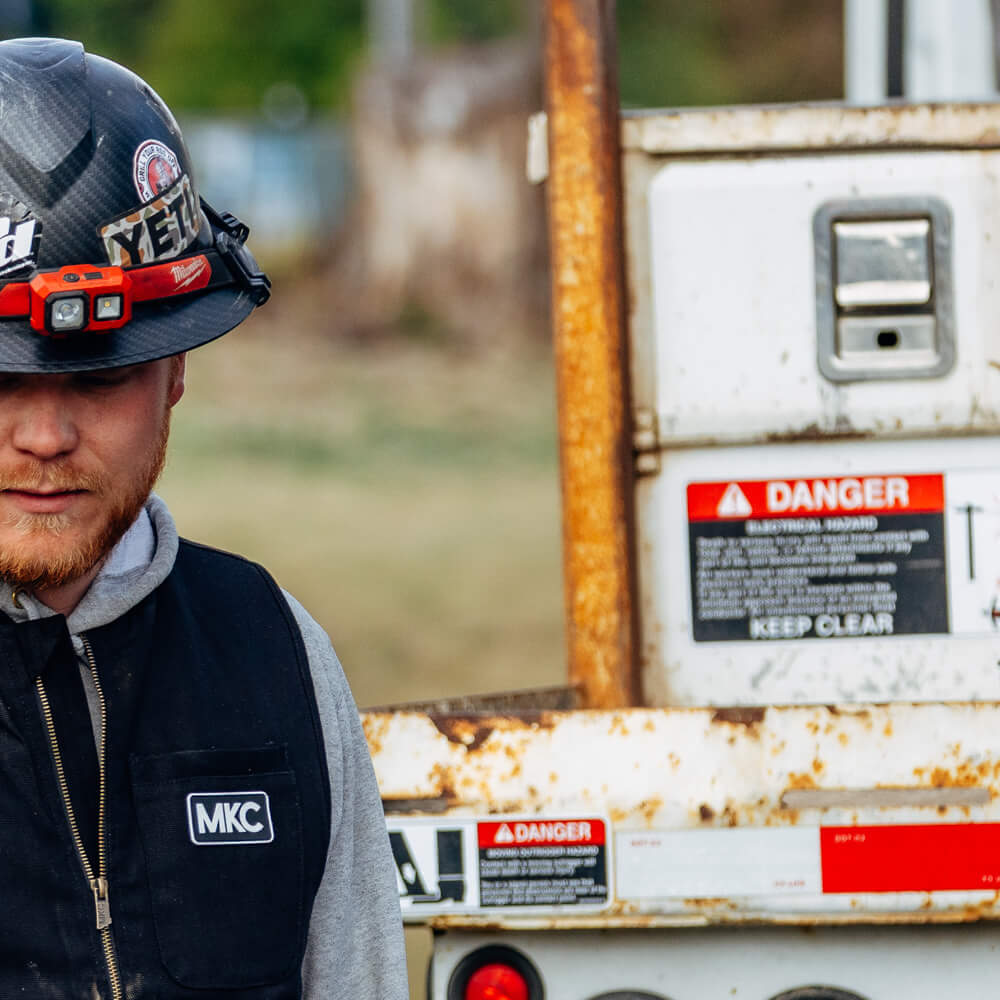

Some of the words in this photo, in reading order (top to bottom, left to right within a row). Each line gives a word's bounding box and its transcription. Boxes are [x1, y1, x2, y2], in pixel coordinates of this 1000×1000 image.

[111, 187, 197, 264] YETI
[766, 477, 910, 513] DANGER
[750, 615, 813, 638] KEEP
[814, 612, 894, 636] CLEAR
[195, 801, 265, 834] MKC
[514, 822, 592, 843] DANGER
